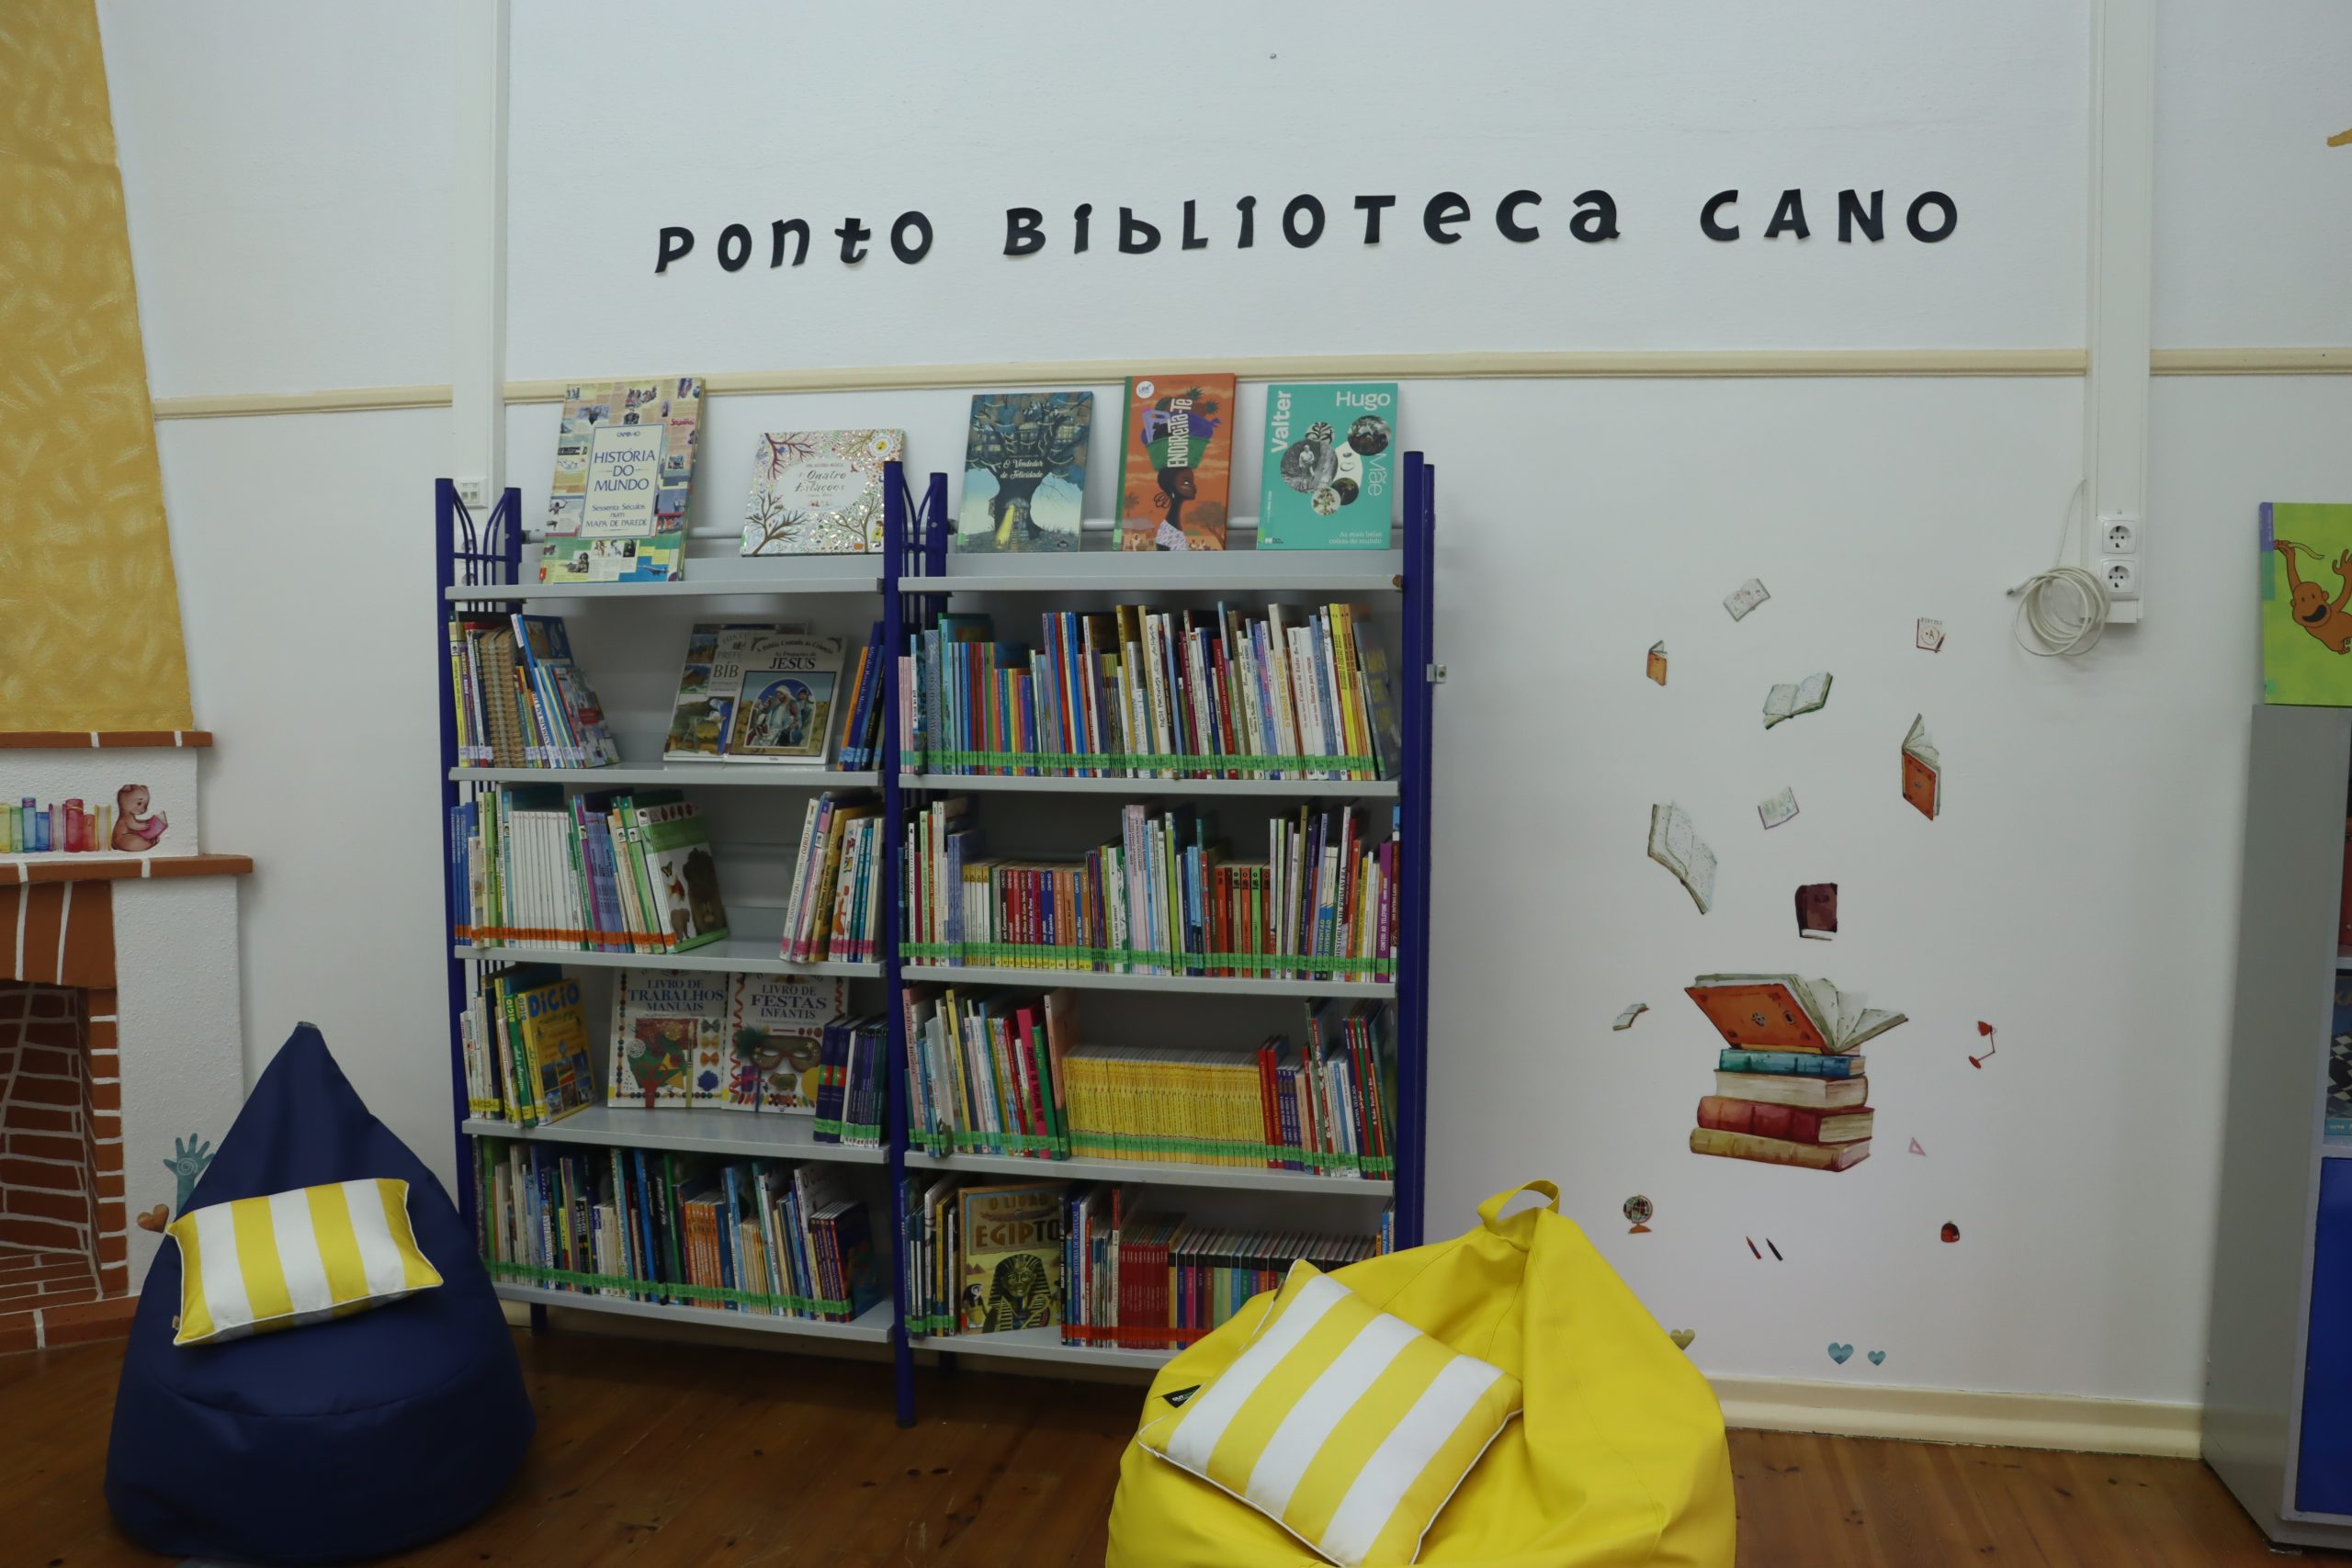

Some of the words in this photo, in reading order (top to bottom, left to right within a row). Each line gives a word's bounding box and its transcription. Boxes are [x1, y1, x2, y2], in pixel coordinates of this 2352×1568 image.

[1700, 188, 1958, 243] CANO
[1336, 391, 1391, 411] Hugo
[1272, 390, 1292, 453] Valter
[594, 448, 655, 463] HISTÓRIA
[1013, 459, 1044, 468] Vendedor
[613, 465, 634, 477] DO
[1010, 470, 1043, 479] Felicidade
[1368, 453, 1386, 496] Mãe
[594, 479, 649, 491] MUNDO
[770, 657, 817, 670] JESUS
[1338, 866, 1347, 908] PRIMAVERA
[647, 979, 684, 989] LIVRO
[688, 979, 705, 988] DE
[629, 989, 724, 1001] TRABALHOS
[763, 984, 798, 995] LIVRO
[801, 987, 817, 997] DE
[647, 1003, 704, 1012] MANUAIS
[752, 994, 828, 1009] FESTAS
[761, 1009, 816, 1020] INFANTIS
[1033, 1084, 1043, 1109] histórias
[1035, 1111, 1045, 1122] 365
[1073, 1240, 1079, 1248] DE
